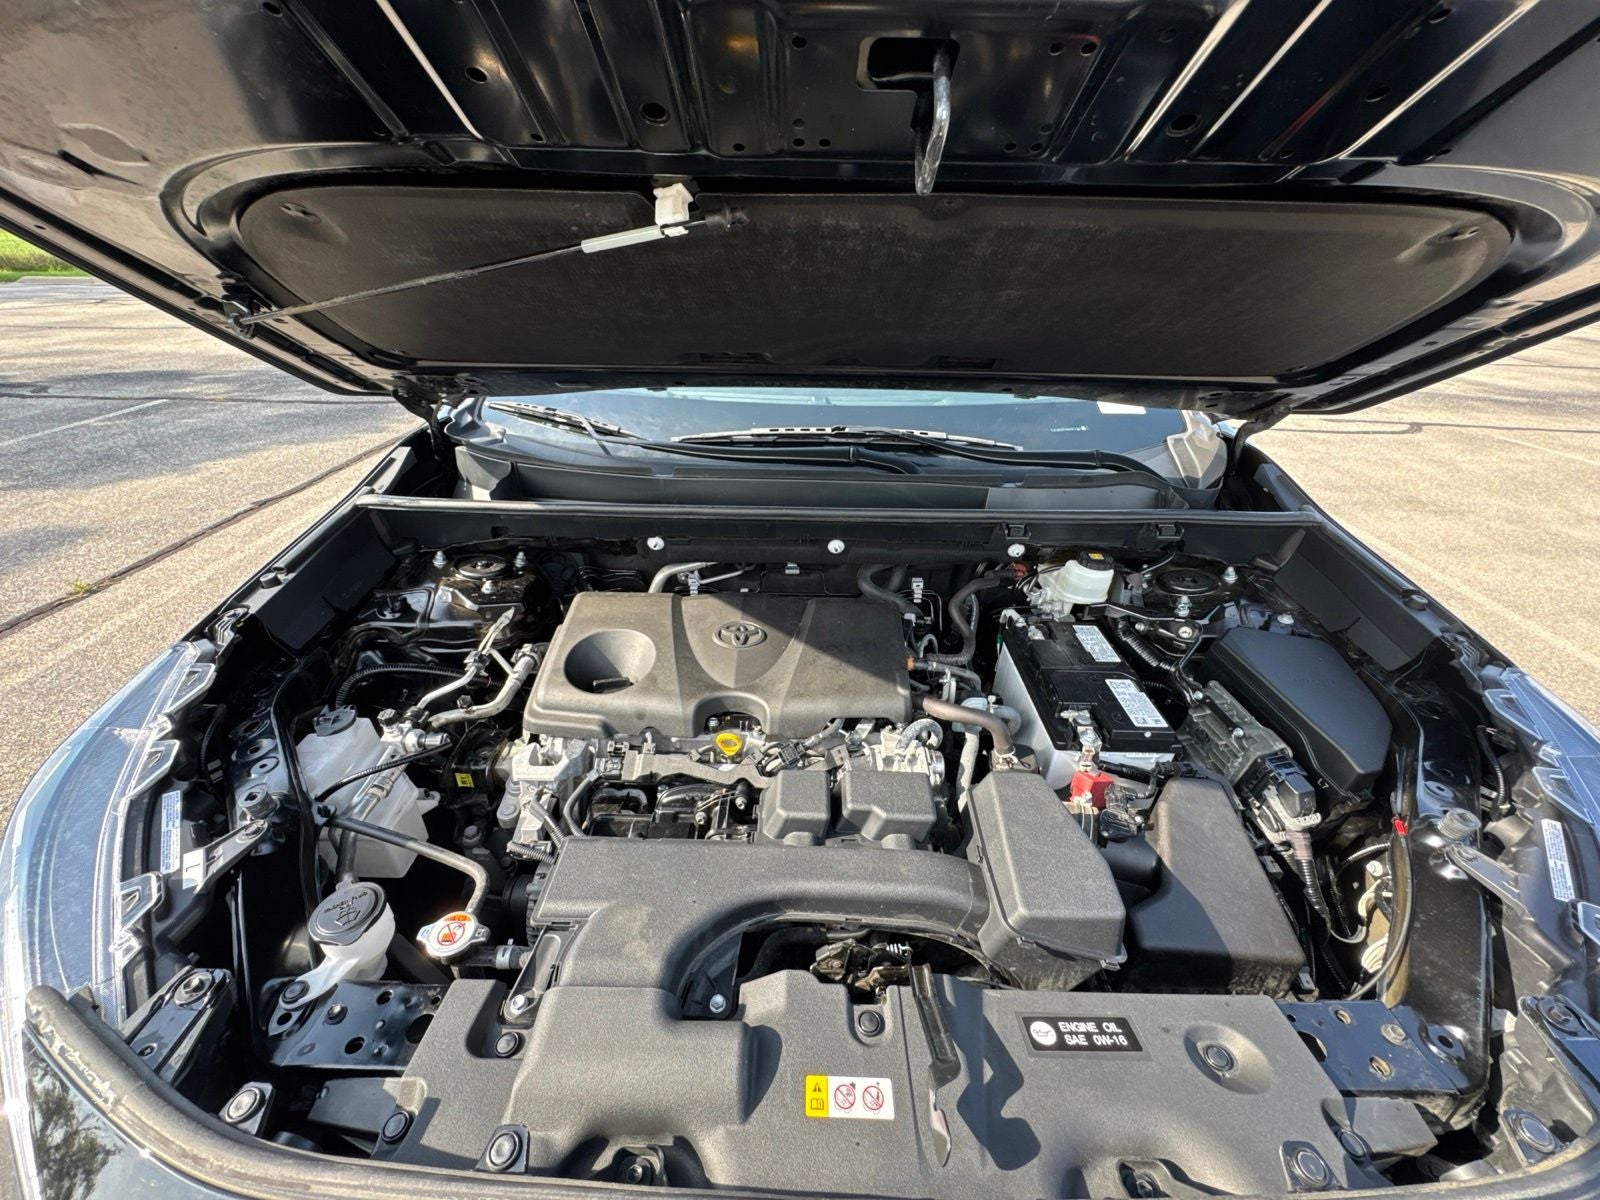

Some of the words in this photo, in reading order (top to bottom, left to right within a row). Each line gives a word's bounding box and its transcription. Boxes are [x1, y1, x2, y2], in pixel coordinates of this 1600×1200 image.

[1058, 1022, 1098, 1032] ENGINE
[1102, 1022, 1122, 1032] OIL
[1064, 1035, 1088, 1045] SAE
[1093, 1035, 1127, 1045] 0W-16
